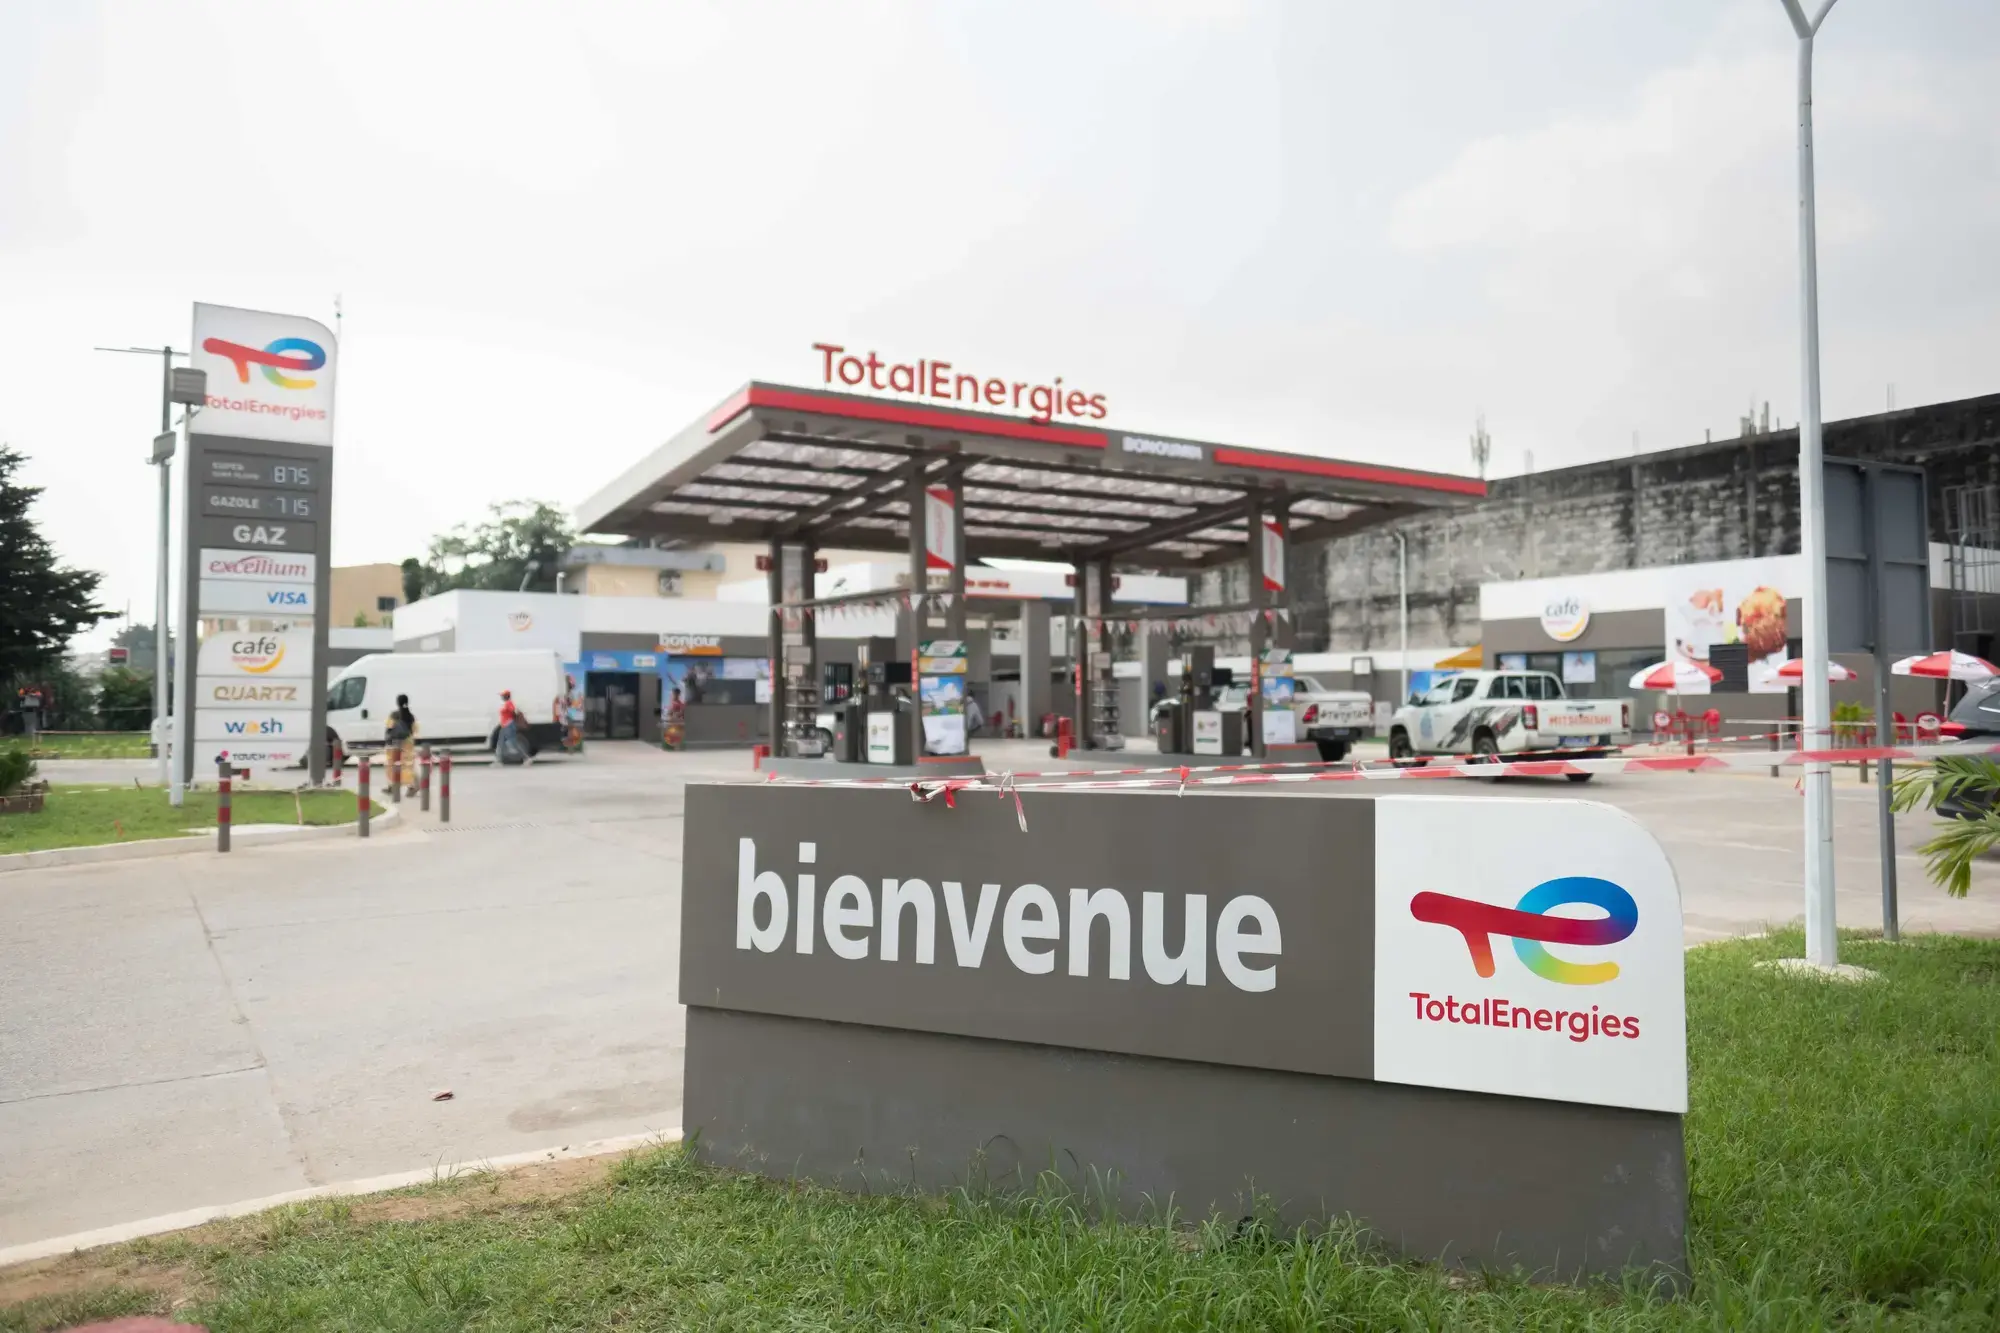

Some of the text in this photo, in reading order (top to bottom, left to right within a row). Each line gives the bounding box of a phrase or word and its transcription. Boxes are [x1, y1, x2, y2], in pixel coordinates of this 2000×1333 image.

[813, 343, 1107, 424] TotalEnergies
[204, 395, 327, 421] TotalEnergies
[275, 466, 309, 484] 875
[211, 495, 259, 509] GAZOLE
[276, 497, 309, 516] 715
[233, 525, 286, 545] GAZ
[209, 556, 307, 576] excellium
[267, 591, 308, 604] VISA
[1545, 597, 1580, 617] café
[232, 636, 277, 655] café
[659, 630, 720, 650] bonjour
[214, 686, 297, 701] QUARTZ
[224, 717, 283, 734] wash
[736, 838, 1282, 992] bienvenue
[1409, 992, 1640, 1042] TotalEnergies
